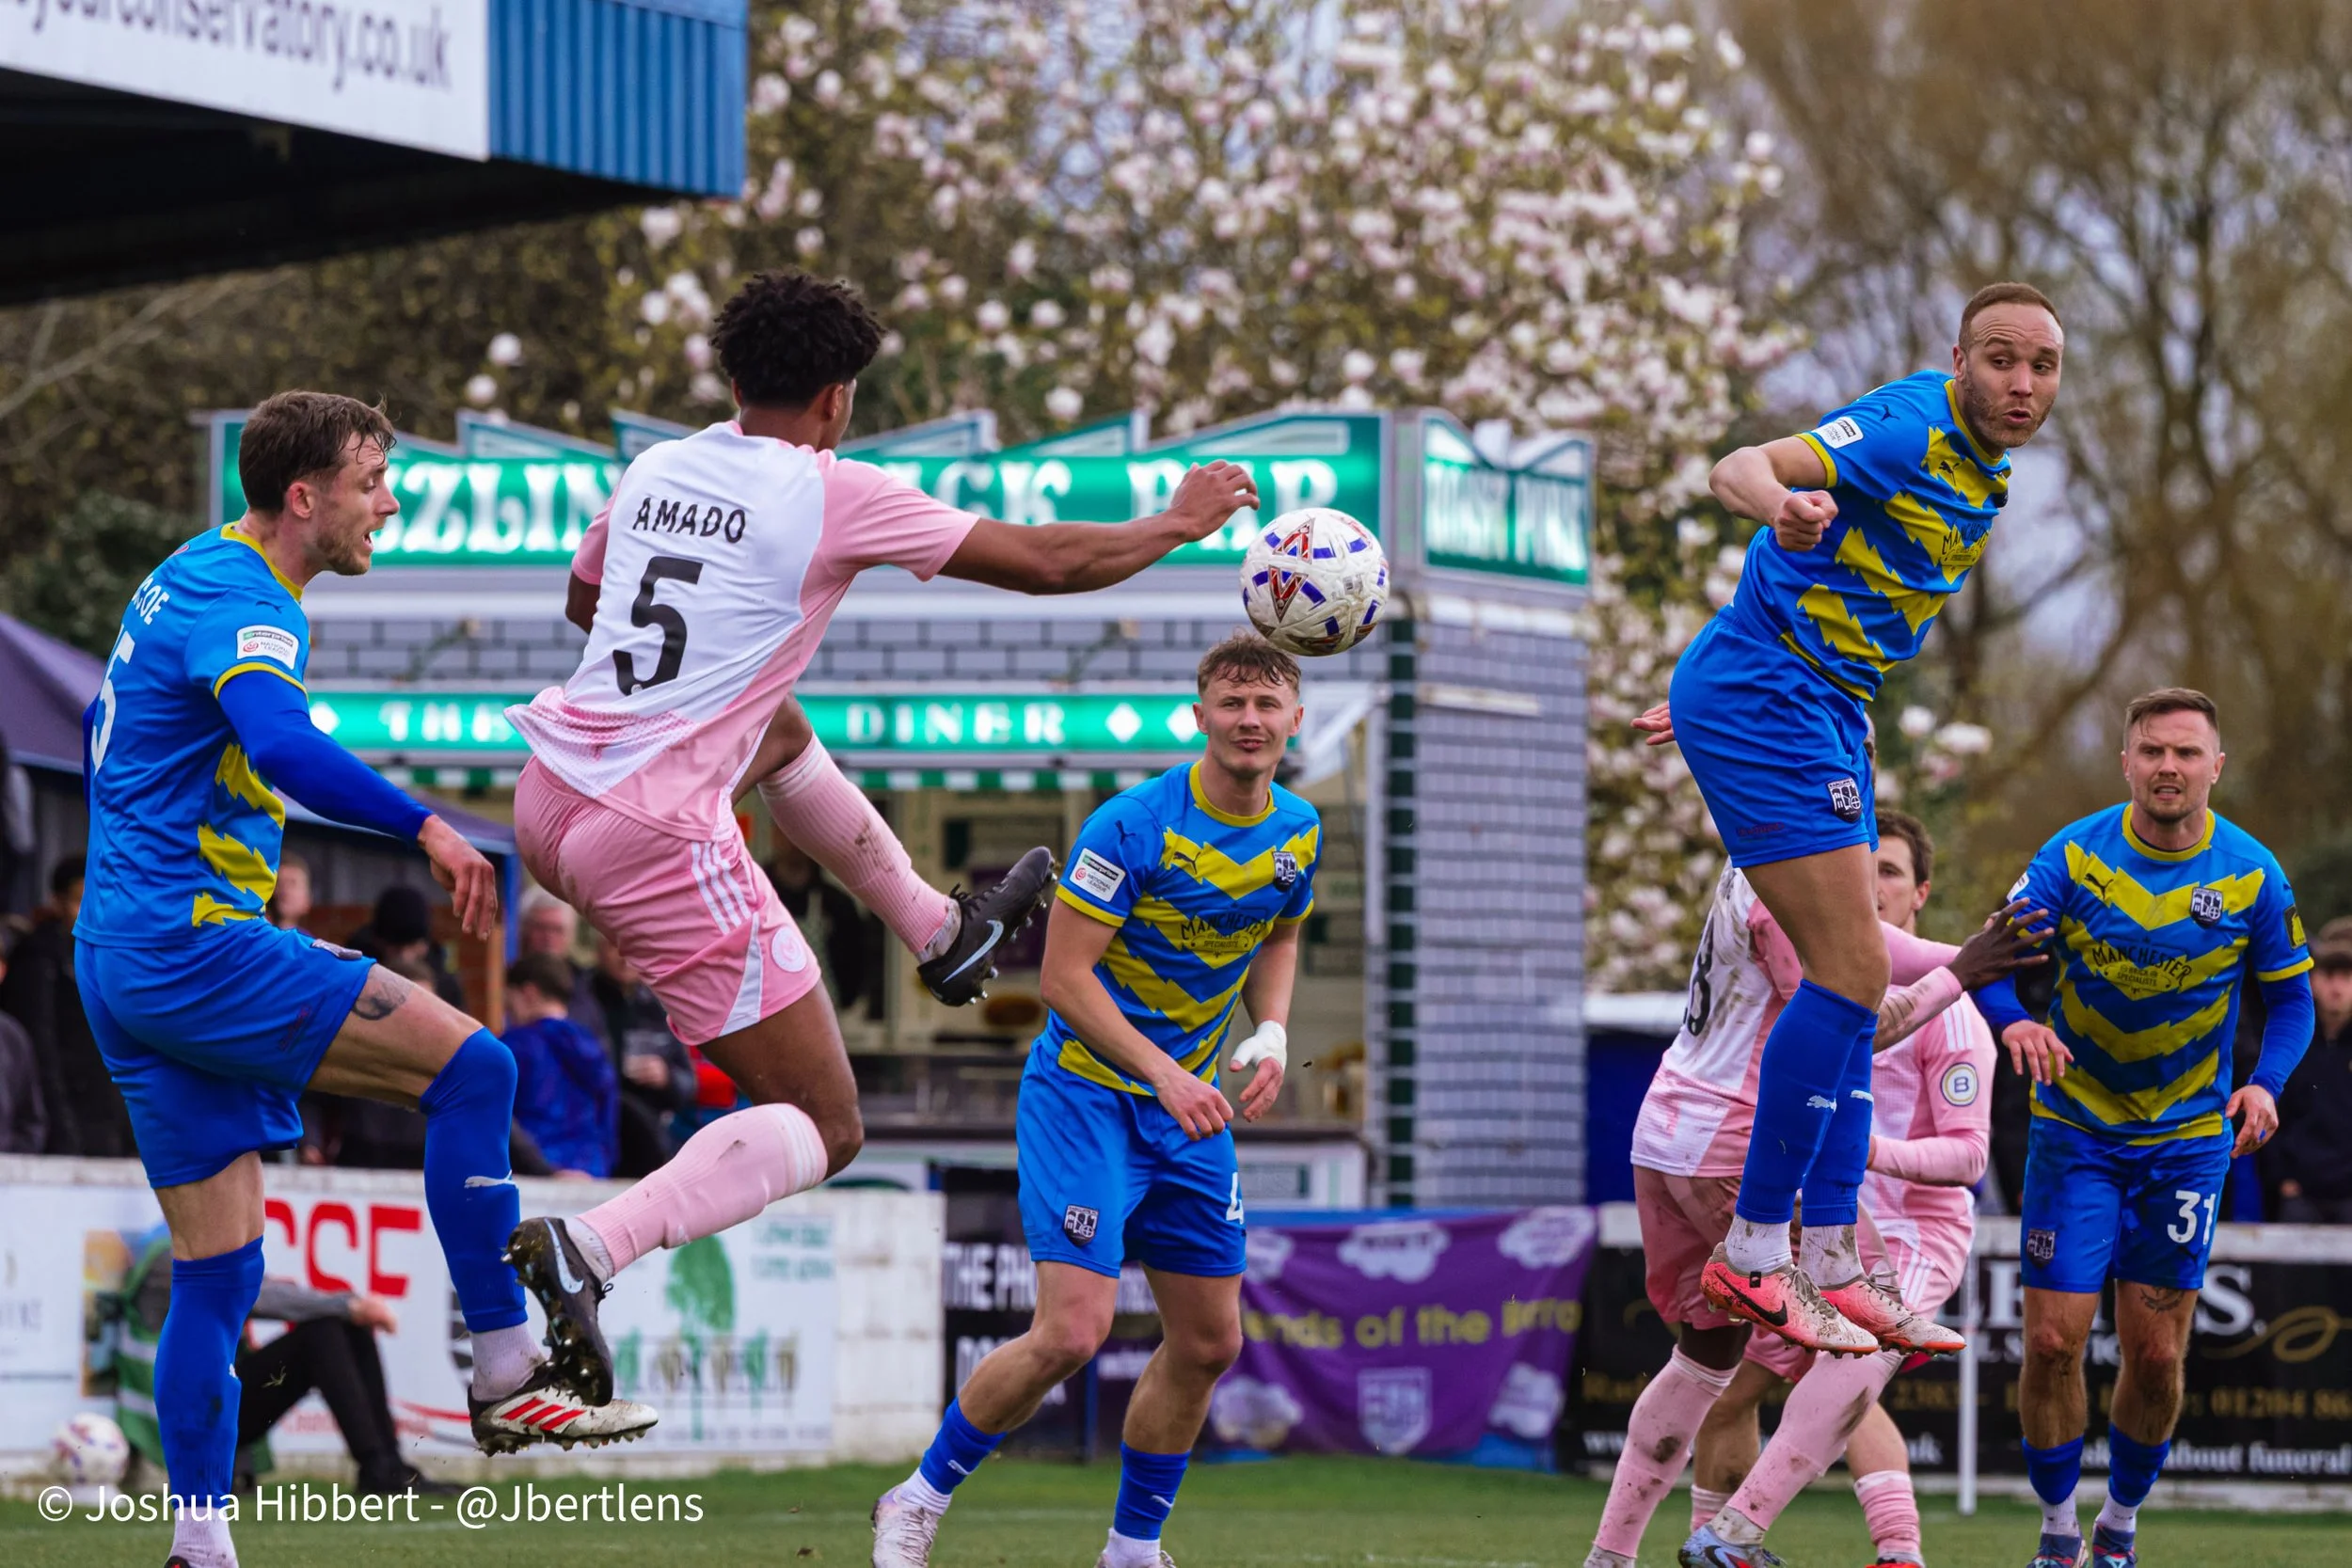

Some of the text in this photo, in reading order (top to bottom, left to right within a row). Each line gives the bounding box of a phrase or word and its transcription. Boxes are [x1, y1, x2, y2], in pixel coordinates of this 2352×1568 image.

[631, 497, 746, 544] AMADO
[613, 555, 704, 696] 5
[378, 701, 1066, 745] THE DINER
[2091, 944, 2192, 987] MANCHESTER
[1954, 1077, 1969, 1093] B
[1226, 1172, 1244, 1225] 4
[2168, 1190, 2217, 1245] 31
[1356, 1307, 1405, 1348] of
[1415, 1305, 1490, 1347] the
[2249, 1441, 2351, 1475] funeral
